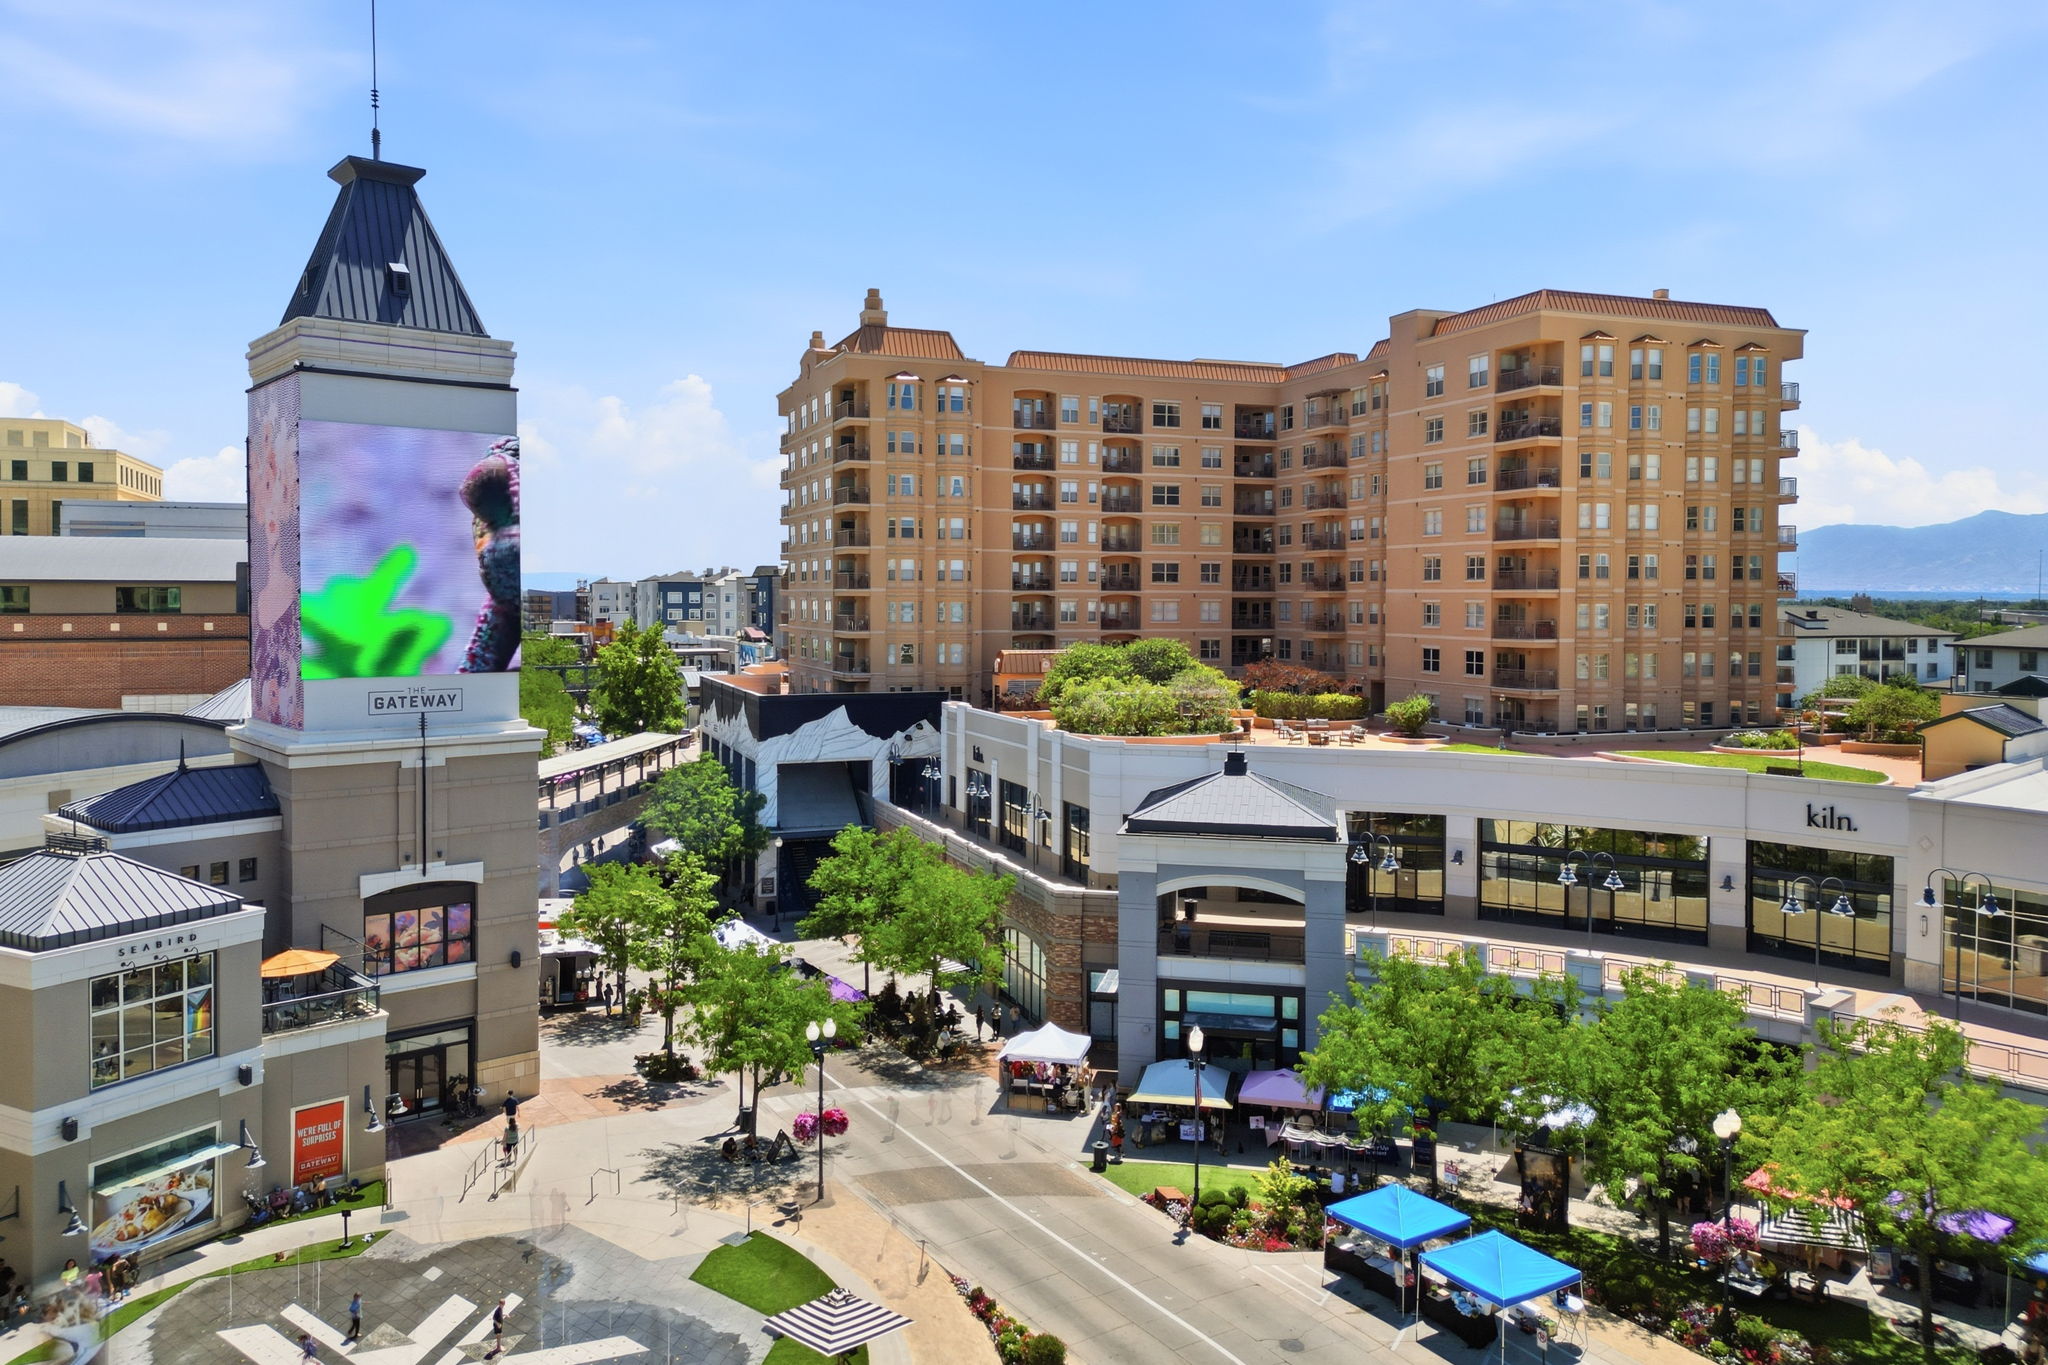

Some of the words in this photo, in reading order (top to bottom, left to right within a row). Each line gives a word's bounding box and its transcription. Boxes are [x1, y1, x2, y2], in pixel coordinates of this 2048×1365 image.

[374, 693, 457, 709] GATEWAY
[1806, 803, 1858, 832] kiln.
[118, 933, 197, 957] SEABIRD
[297, 1125, 318, 1138] WE'RE
[317, 1122, 333, 1133] FULL
[333, 1119, 342, 1129] OF
[302, 1130, 337, 1147] SURPRISES
[300, 1155, 337, 1170] GATEWAY
